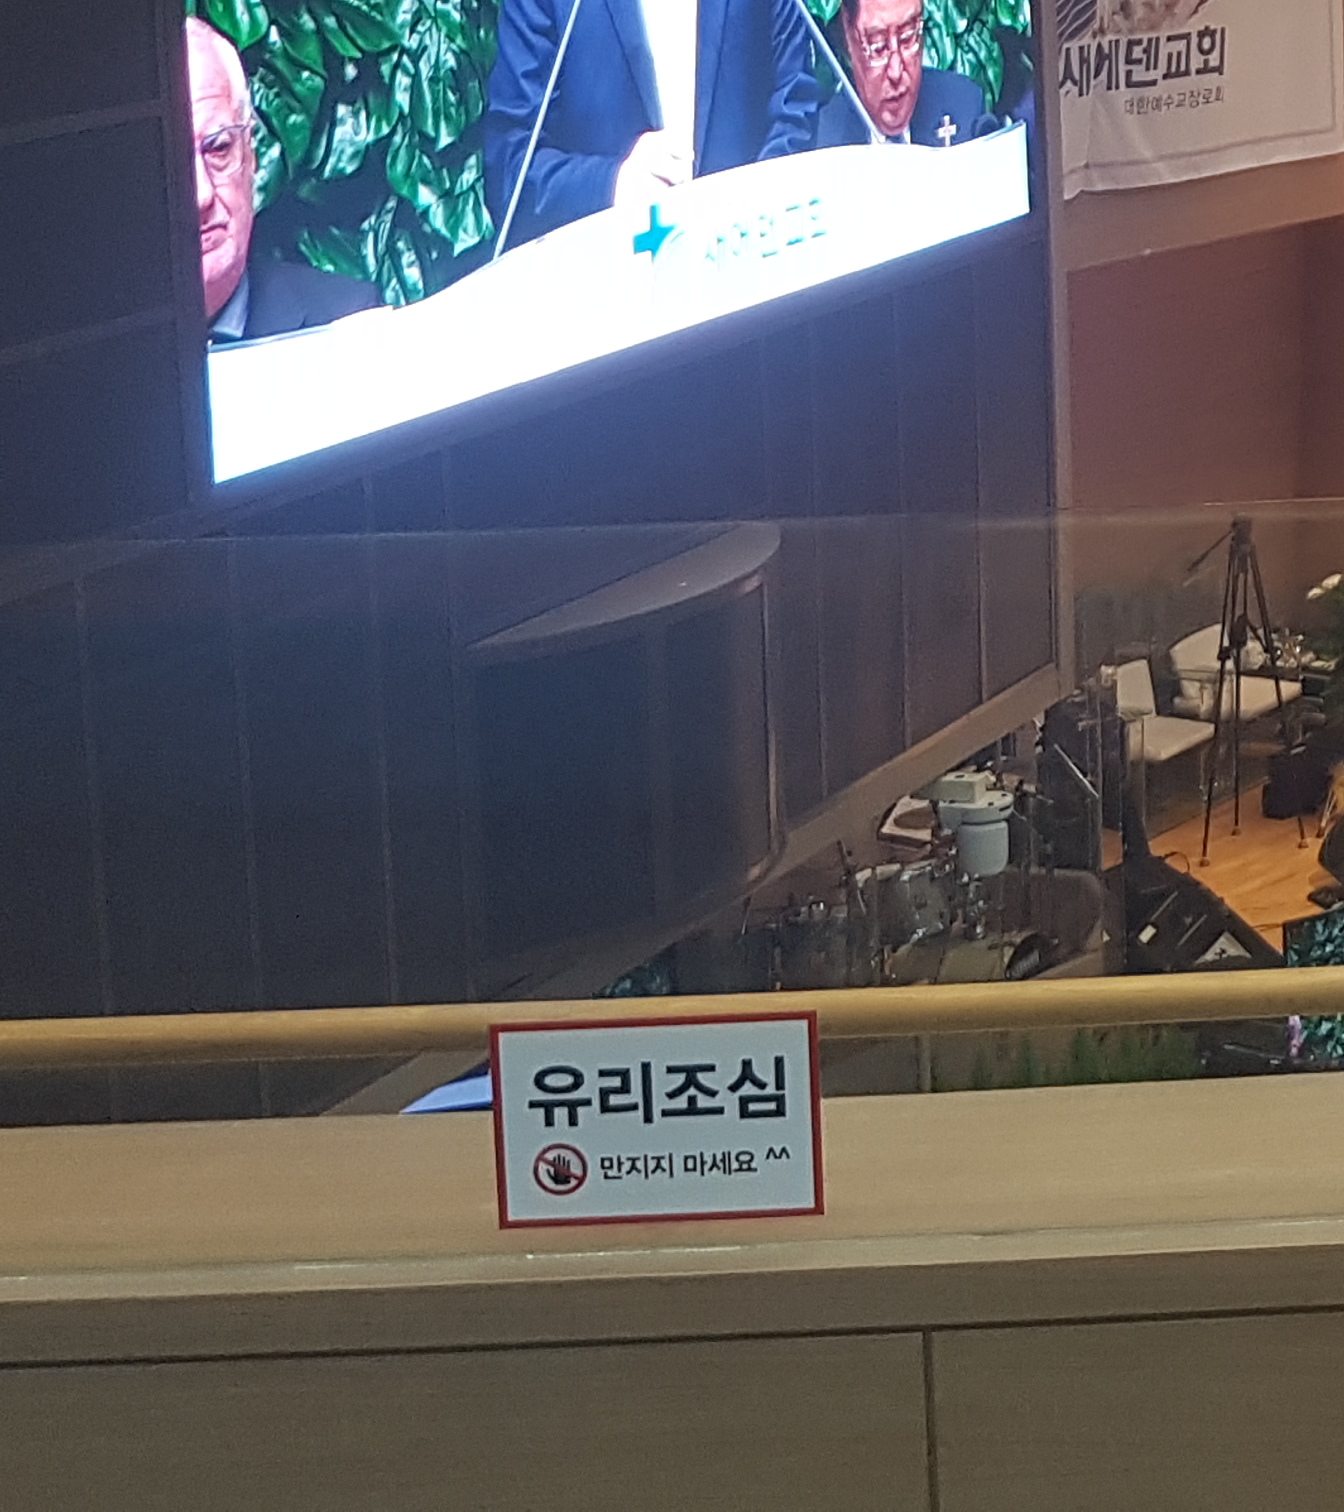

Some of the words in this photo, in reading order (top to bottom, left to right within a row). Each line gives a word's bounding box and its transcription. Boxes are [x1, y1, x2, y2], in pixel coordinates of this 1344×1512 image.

[1059, 25, 1227, 97] 새에덴교회
[527, 1055, 787, 1128] 유리조심
[600, 1152, 675, 1180] 만지지
[683, 1149, 758, 1177] 마세요
